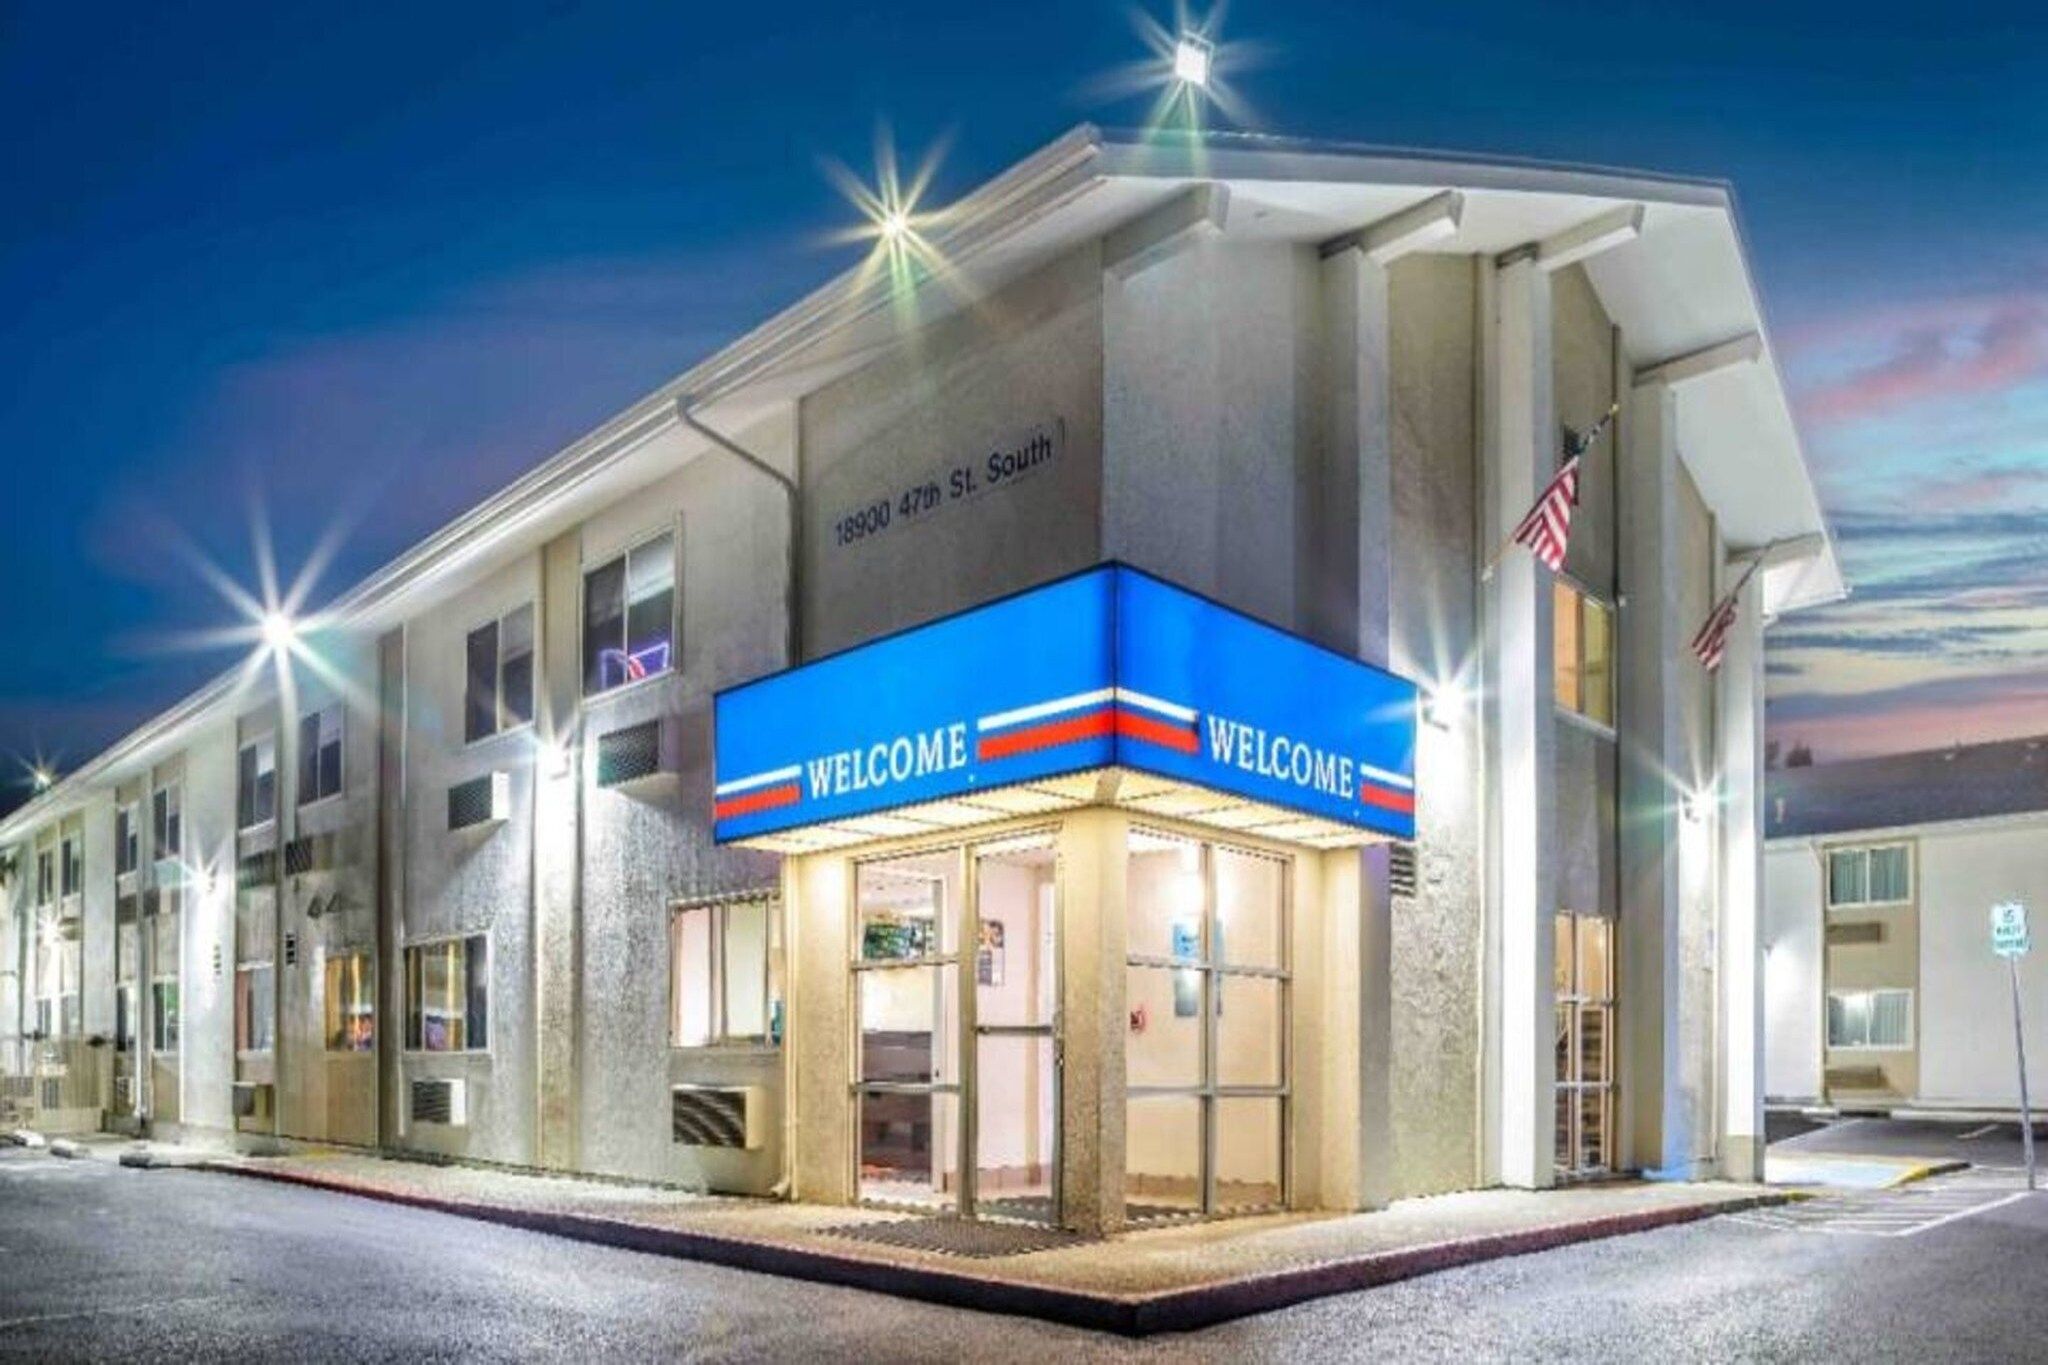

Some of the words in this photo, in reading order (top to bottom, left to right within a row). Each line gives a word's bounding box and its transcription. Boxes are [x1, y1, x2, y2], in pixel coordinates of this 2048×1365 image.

[899, 481, 941, 518] 47th
[986, 432, 1051, 483] South
[806, 721, 967, 800] WELCOME
[1207, 714, 1354, 800] WELCOME
